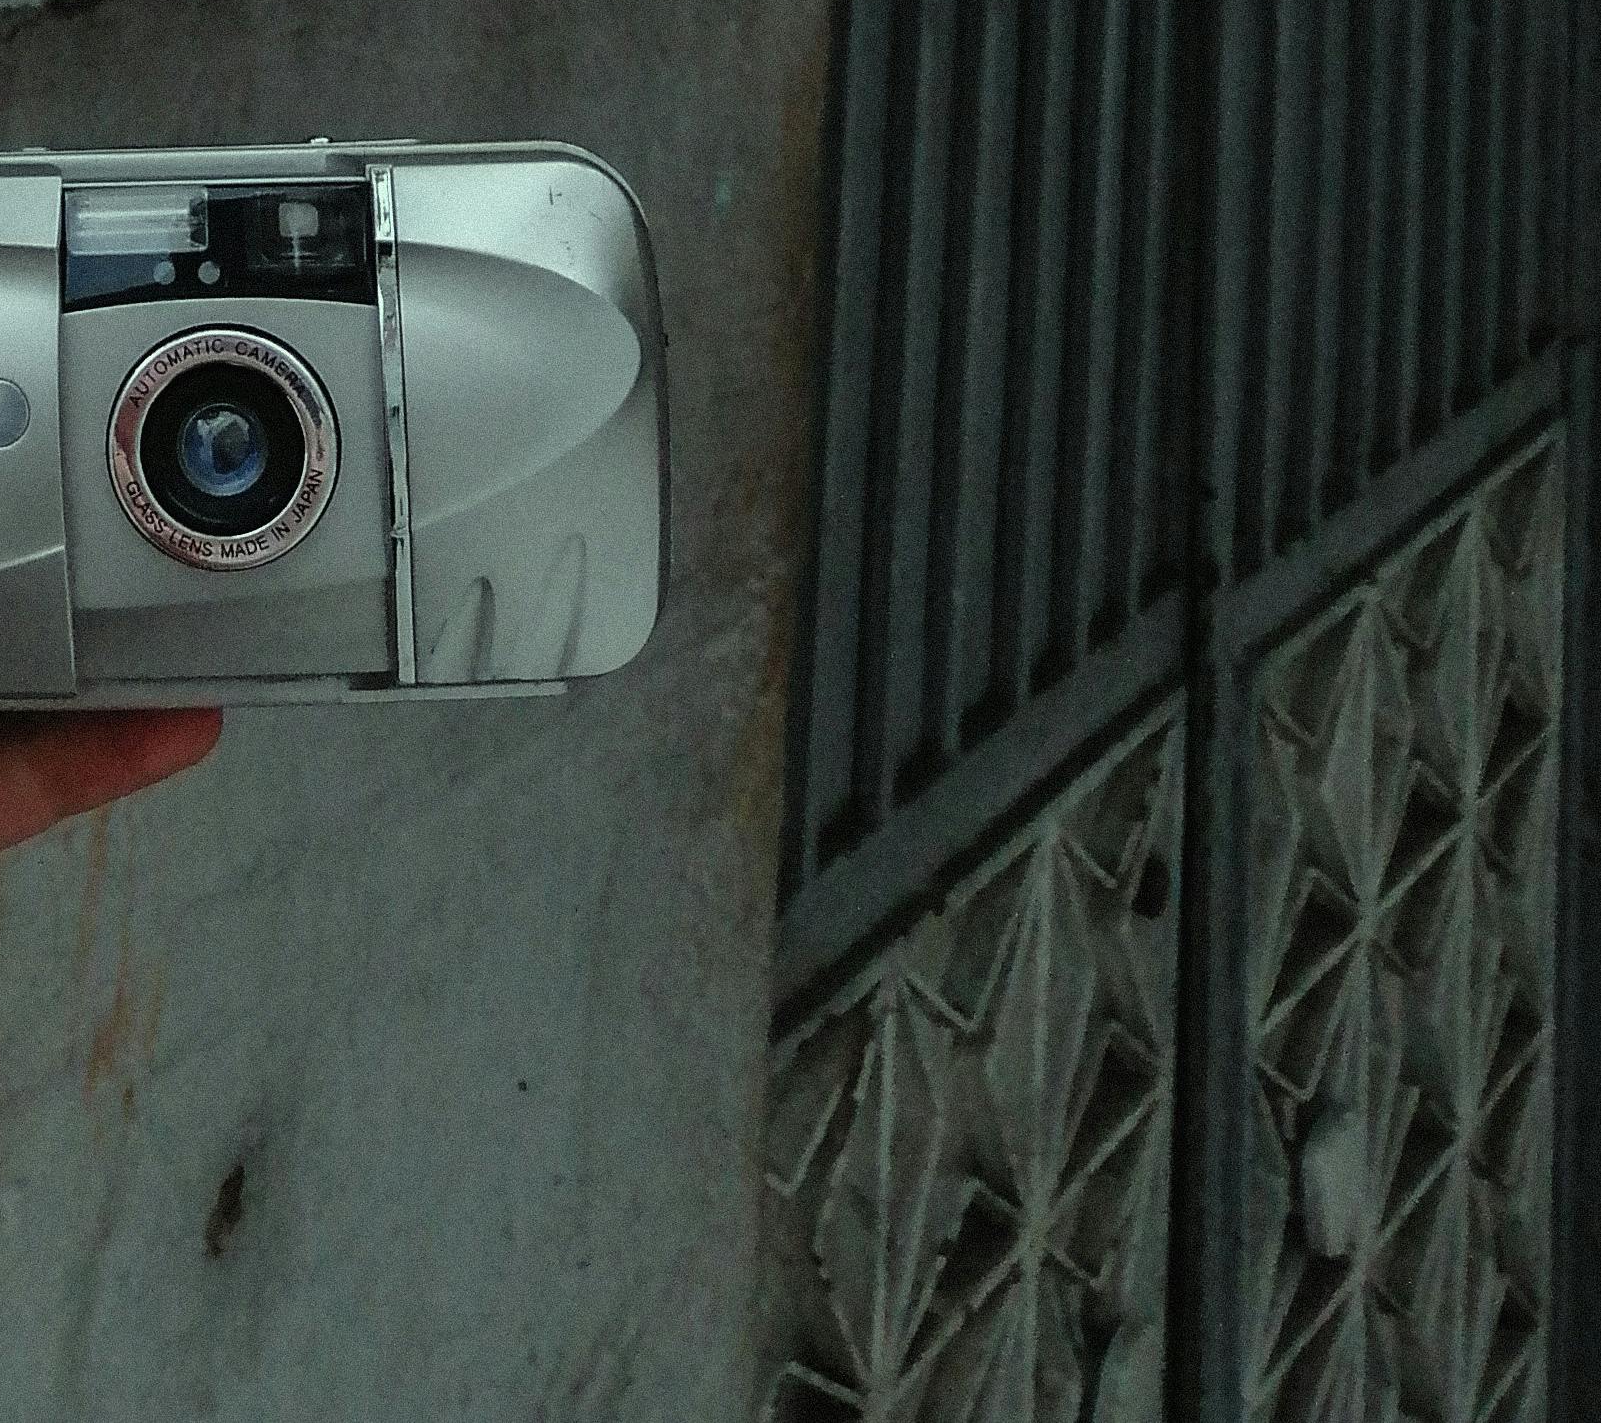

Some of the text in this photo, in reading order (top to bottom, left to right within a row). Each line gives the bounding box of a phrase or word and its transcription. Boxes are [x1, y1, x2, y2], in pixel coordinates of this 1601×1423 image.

[128, 338, 310, 407] AUTOMATIC CAMERA
[126, 469, 324, 559] GLASS LENS MADE IN JAPAN
